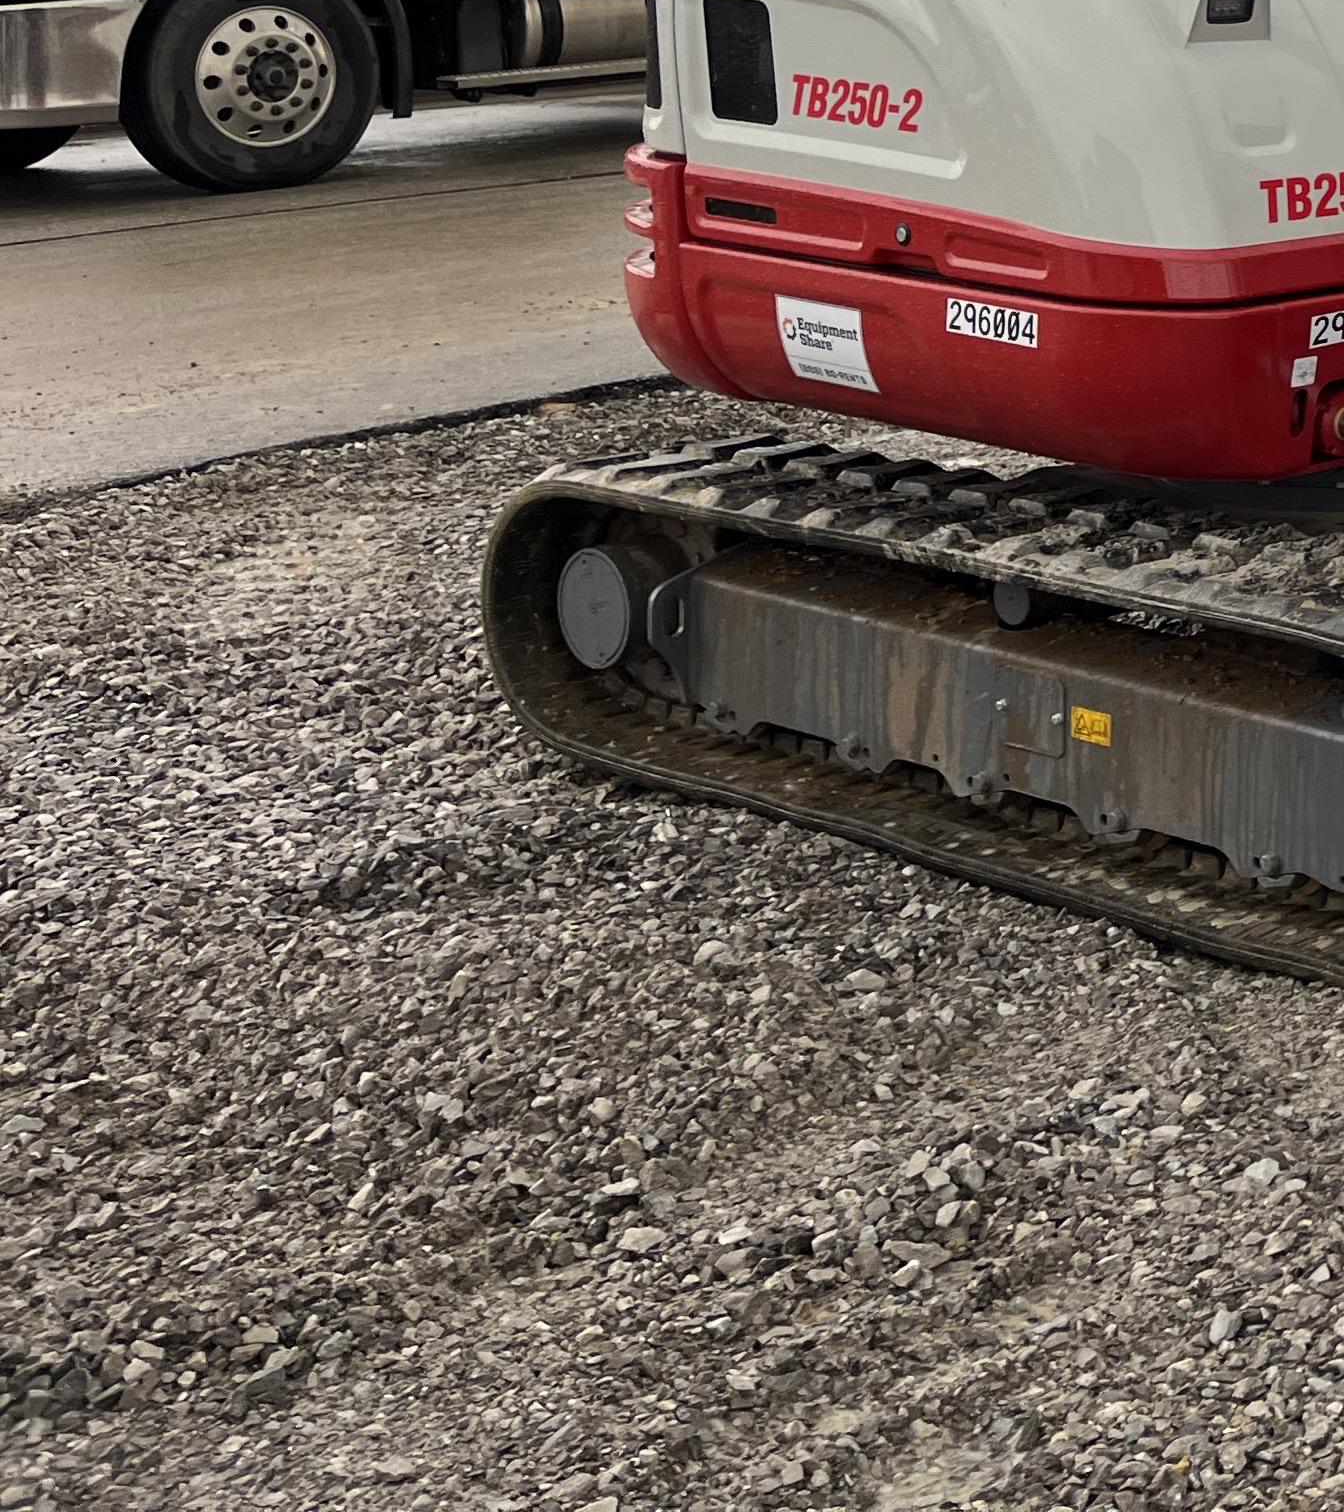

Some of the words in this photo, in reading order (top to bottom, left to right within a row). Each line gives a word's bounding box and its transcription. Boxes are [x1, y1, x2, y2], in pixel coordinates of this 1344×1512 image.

[792, 73, 923, 133] TB250-2
[796, 316, 859, 342] Equipment
[948, 300, 1036, 345] 296004
[799, 332, 833, 351] Share
